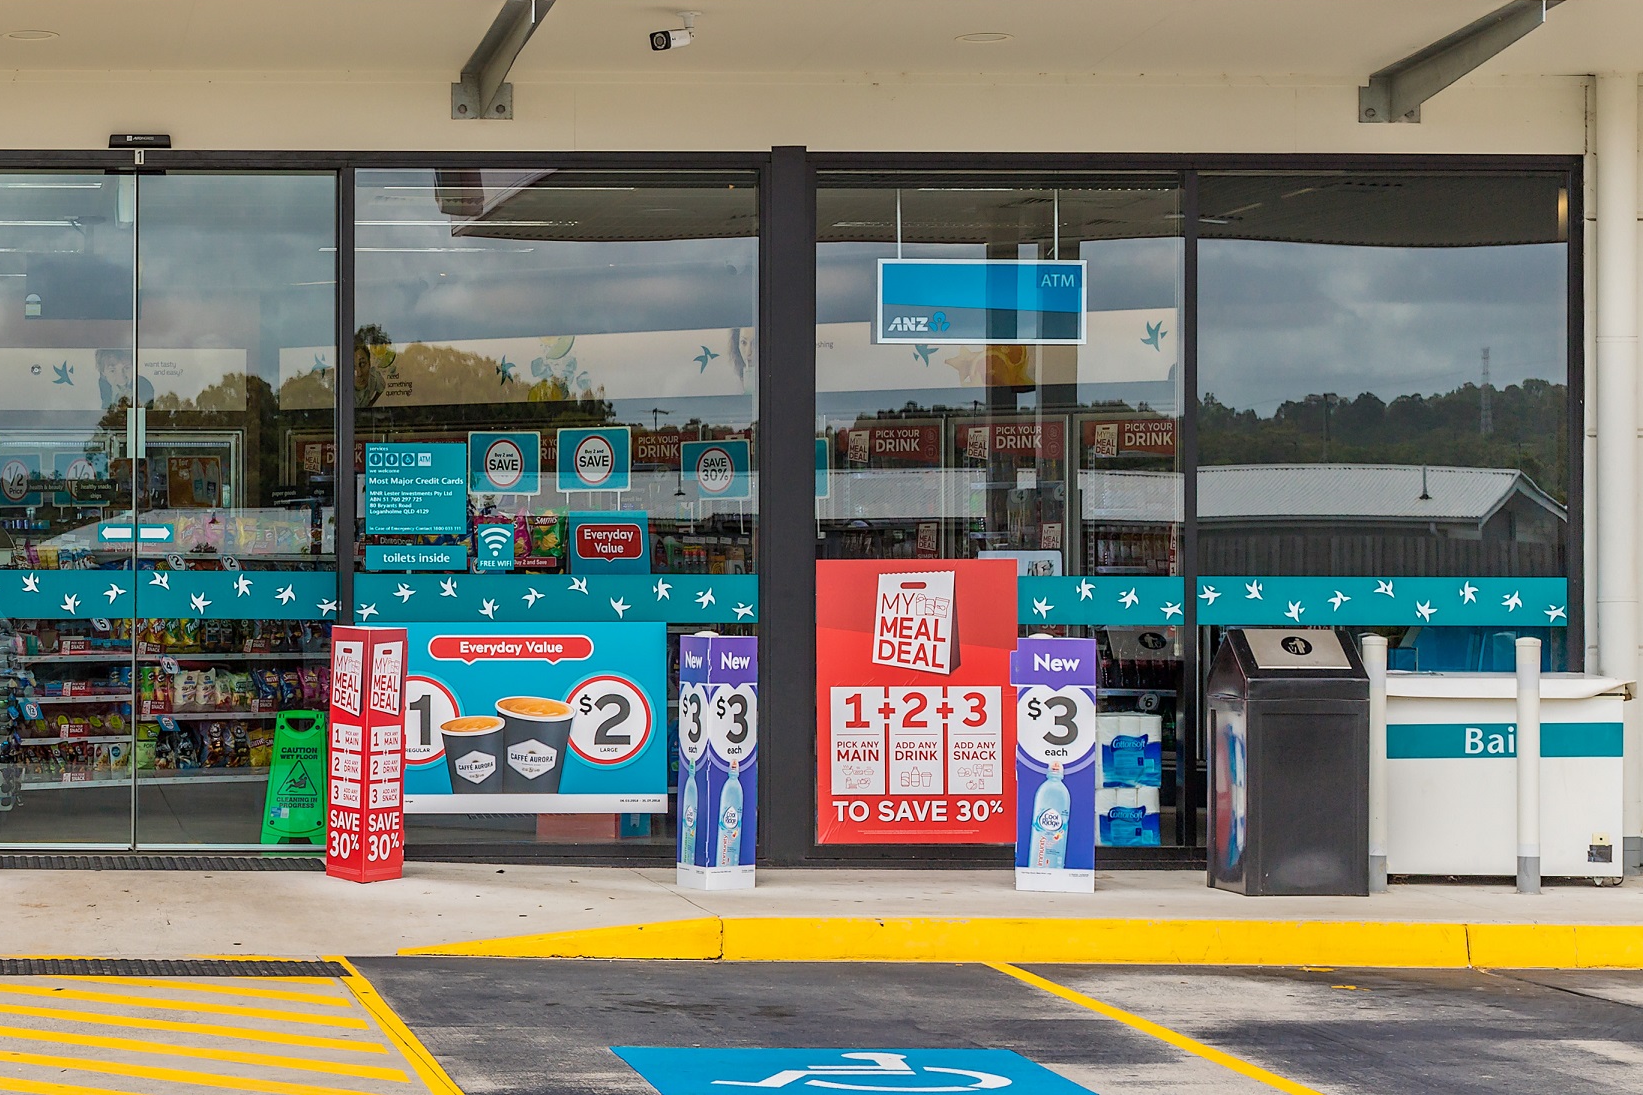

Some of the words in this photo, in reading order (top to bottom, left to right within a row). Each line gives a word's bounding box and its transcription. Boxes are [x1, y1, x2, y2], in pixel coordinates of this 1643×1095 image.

[1041, 274, 1074, 287] ATM
[888, 317, 928, 331] ANZ
[996, 426, 1015, 435] PICK
[1018, 426, 1042, 434] YOUR
[1124, 423, 1146, 432] PICK
[1148, 422, 1173, 431] YOUR
[658, 436, 679, 444] YOUR
[876, 430, 894, 438] PICK
[896, 430, 920, 438] YOUR
[1124, 432, 1173, 446] DRINK
[876, 439, 920, 452] DRINK
[996, 435, 1042, 449] DRINK
[638, 444, 679, 458] DRINK
[489, 460, 519, 471] SAVE
[579, 455, 609, 467] SAVE
[703, 458, 727, 468] SAVE
[702, 469, 728, 481] 30%
[391, 478, 413, 486] Major
[584, 529, 633, 542] Everyday
[594, 542, 624, 554] Value
[383, 553, 416, 563] toilets
[419, 553, 450, 563] inside
[881, 593, 915, 615] MY
[880, 617, 946, 643] MEAL
[460, 642, 522, 656] Everyday
[526, 642, 563, 653] Value
[878, 639, 944, 669] DEAL
[685, 651, 703, 669] New
[721, 652, 750, 670] New
[1034, 653, 1080, 672] New
[335, 672, 358, 693] MEAL
[374, 675, 398, 692] MEAL
[334, 688, 357, 711] DEAL
[373, 692, 396, 711] DEAL
[580, 694, 631, 745] $2
[683, 693, 701, 743] $3
[1027, 696, 1078, 746] $3
[345, 736, 359, 746] MAIN
[384, 736, 398, 745] MAIN
[954, 741, 974, 749] ADD
[977, 741, 996, 749] ANY
[1112, 739, 1146, 749] Cottonsoft
[1465, 727, 1516, 755] Bai
[727, 746, 742, 754] each
[837, 750, 879, 762] MAIN
[895, 751, 937, 761] DRINK
[953, 751, 996, 761] SNACK
[1045, 748, 1068, 757] each
[529, 755, 553, 763] AURORA
[344, 764, 358, 774] DRINK
[383, 765, 398, 774] DRINK
[474, 761, 493, 770] AURORA
[343, 793, 358, 802] SNACK
[382, 794, 397, 802] SNACK
[833, 800, 869, 822] TO
[878, 800, 948, 822] SAVE
[956, 800, 1003, 822] 30%
[1109, 809, 1144, 819] Cottonsoft
[330, 810, 360, 831] SAVE
[368, 812, 399, 832] SAVE
[330, 830, 359, 859] 30%
[368, 832, 399, 862] 30%
[1037, 836, 1046, 867] immunity
